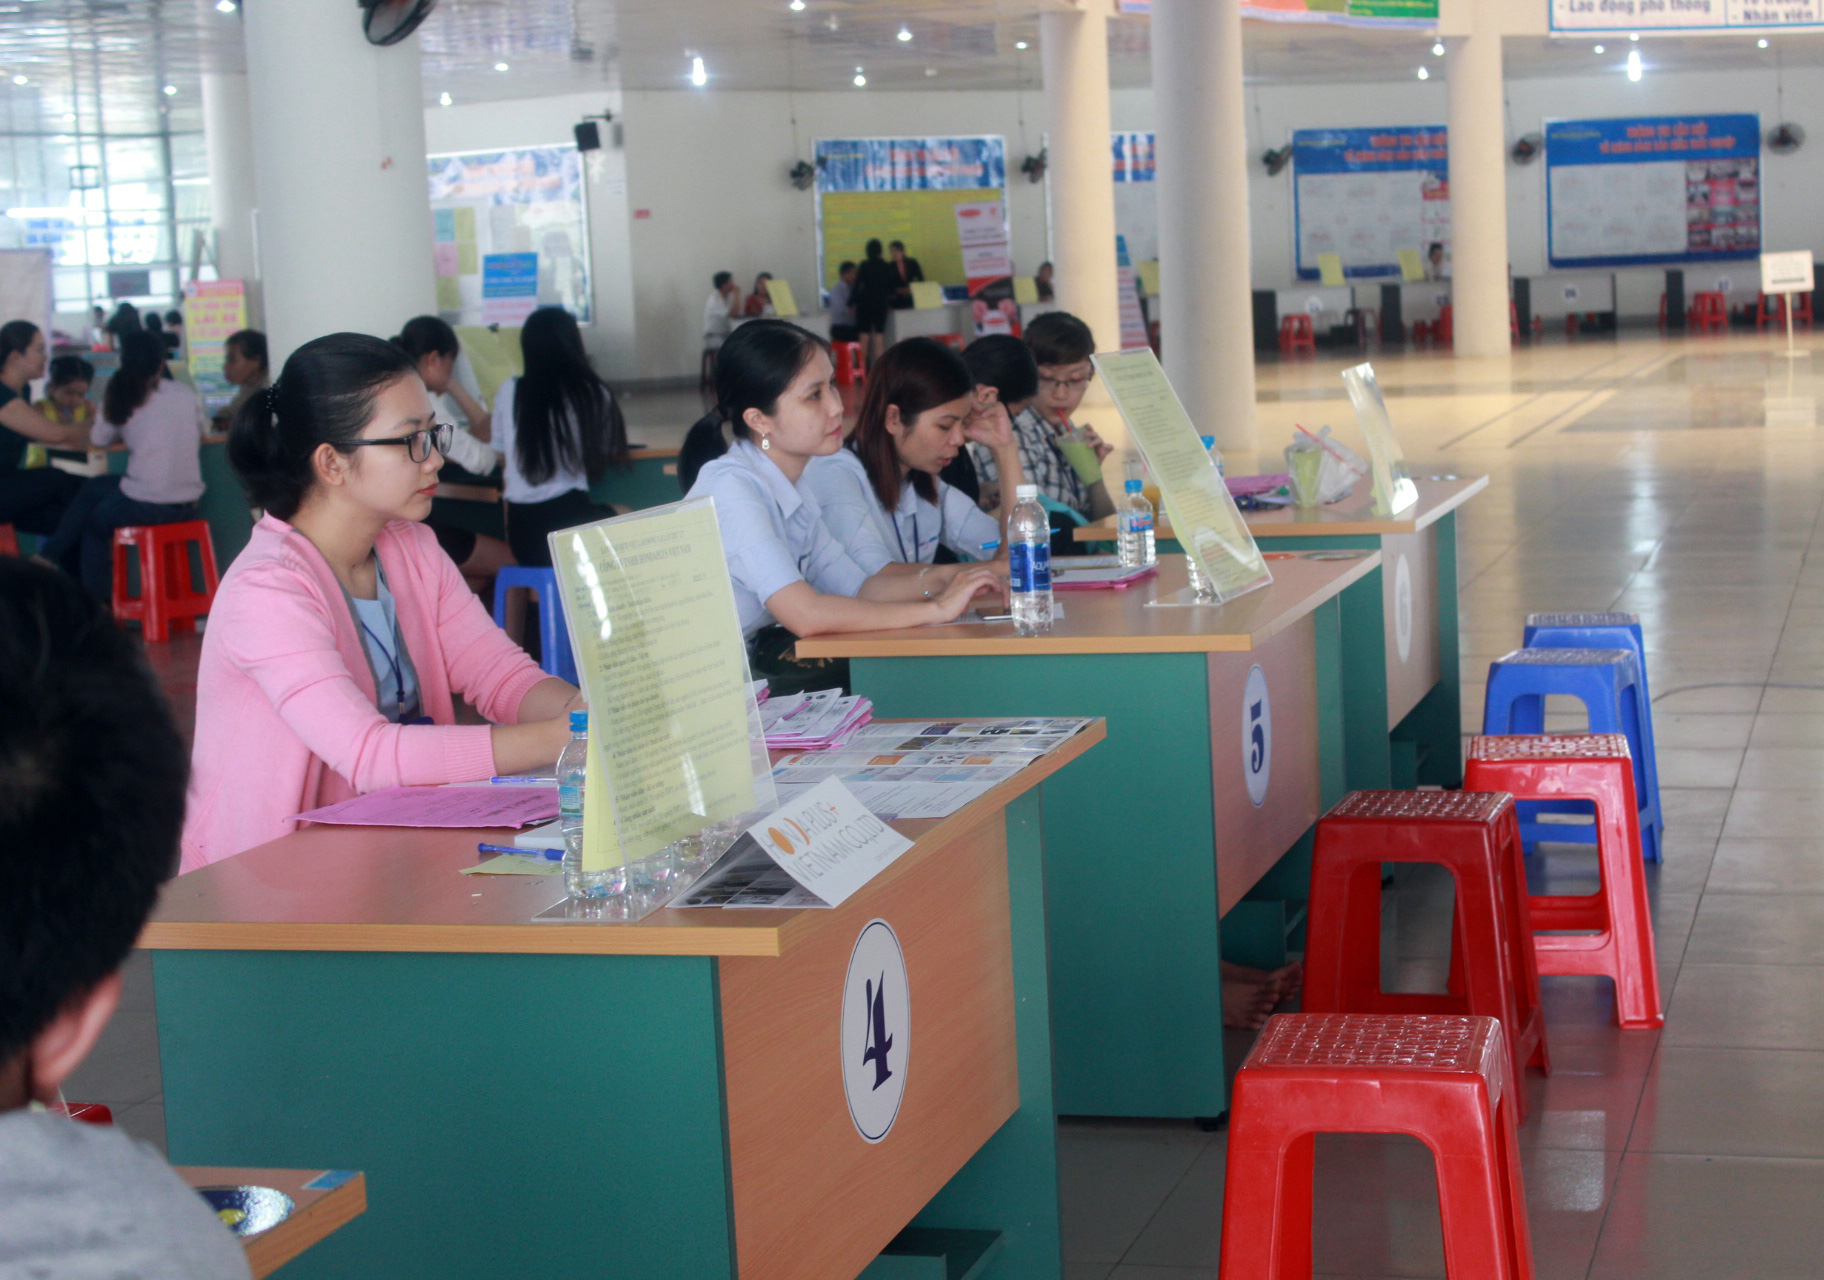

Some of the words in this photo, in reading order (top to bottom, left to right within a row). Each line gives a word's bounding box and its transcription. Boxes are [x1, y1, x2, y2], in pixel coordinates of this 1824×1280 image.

[1570, 0, 1594, 12] Lao
[1250, 698, 1264, 774] 5
[787, 836, 855, 882] VIETNAM
[862, 969, 893, 1092] 4
